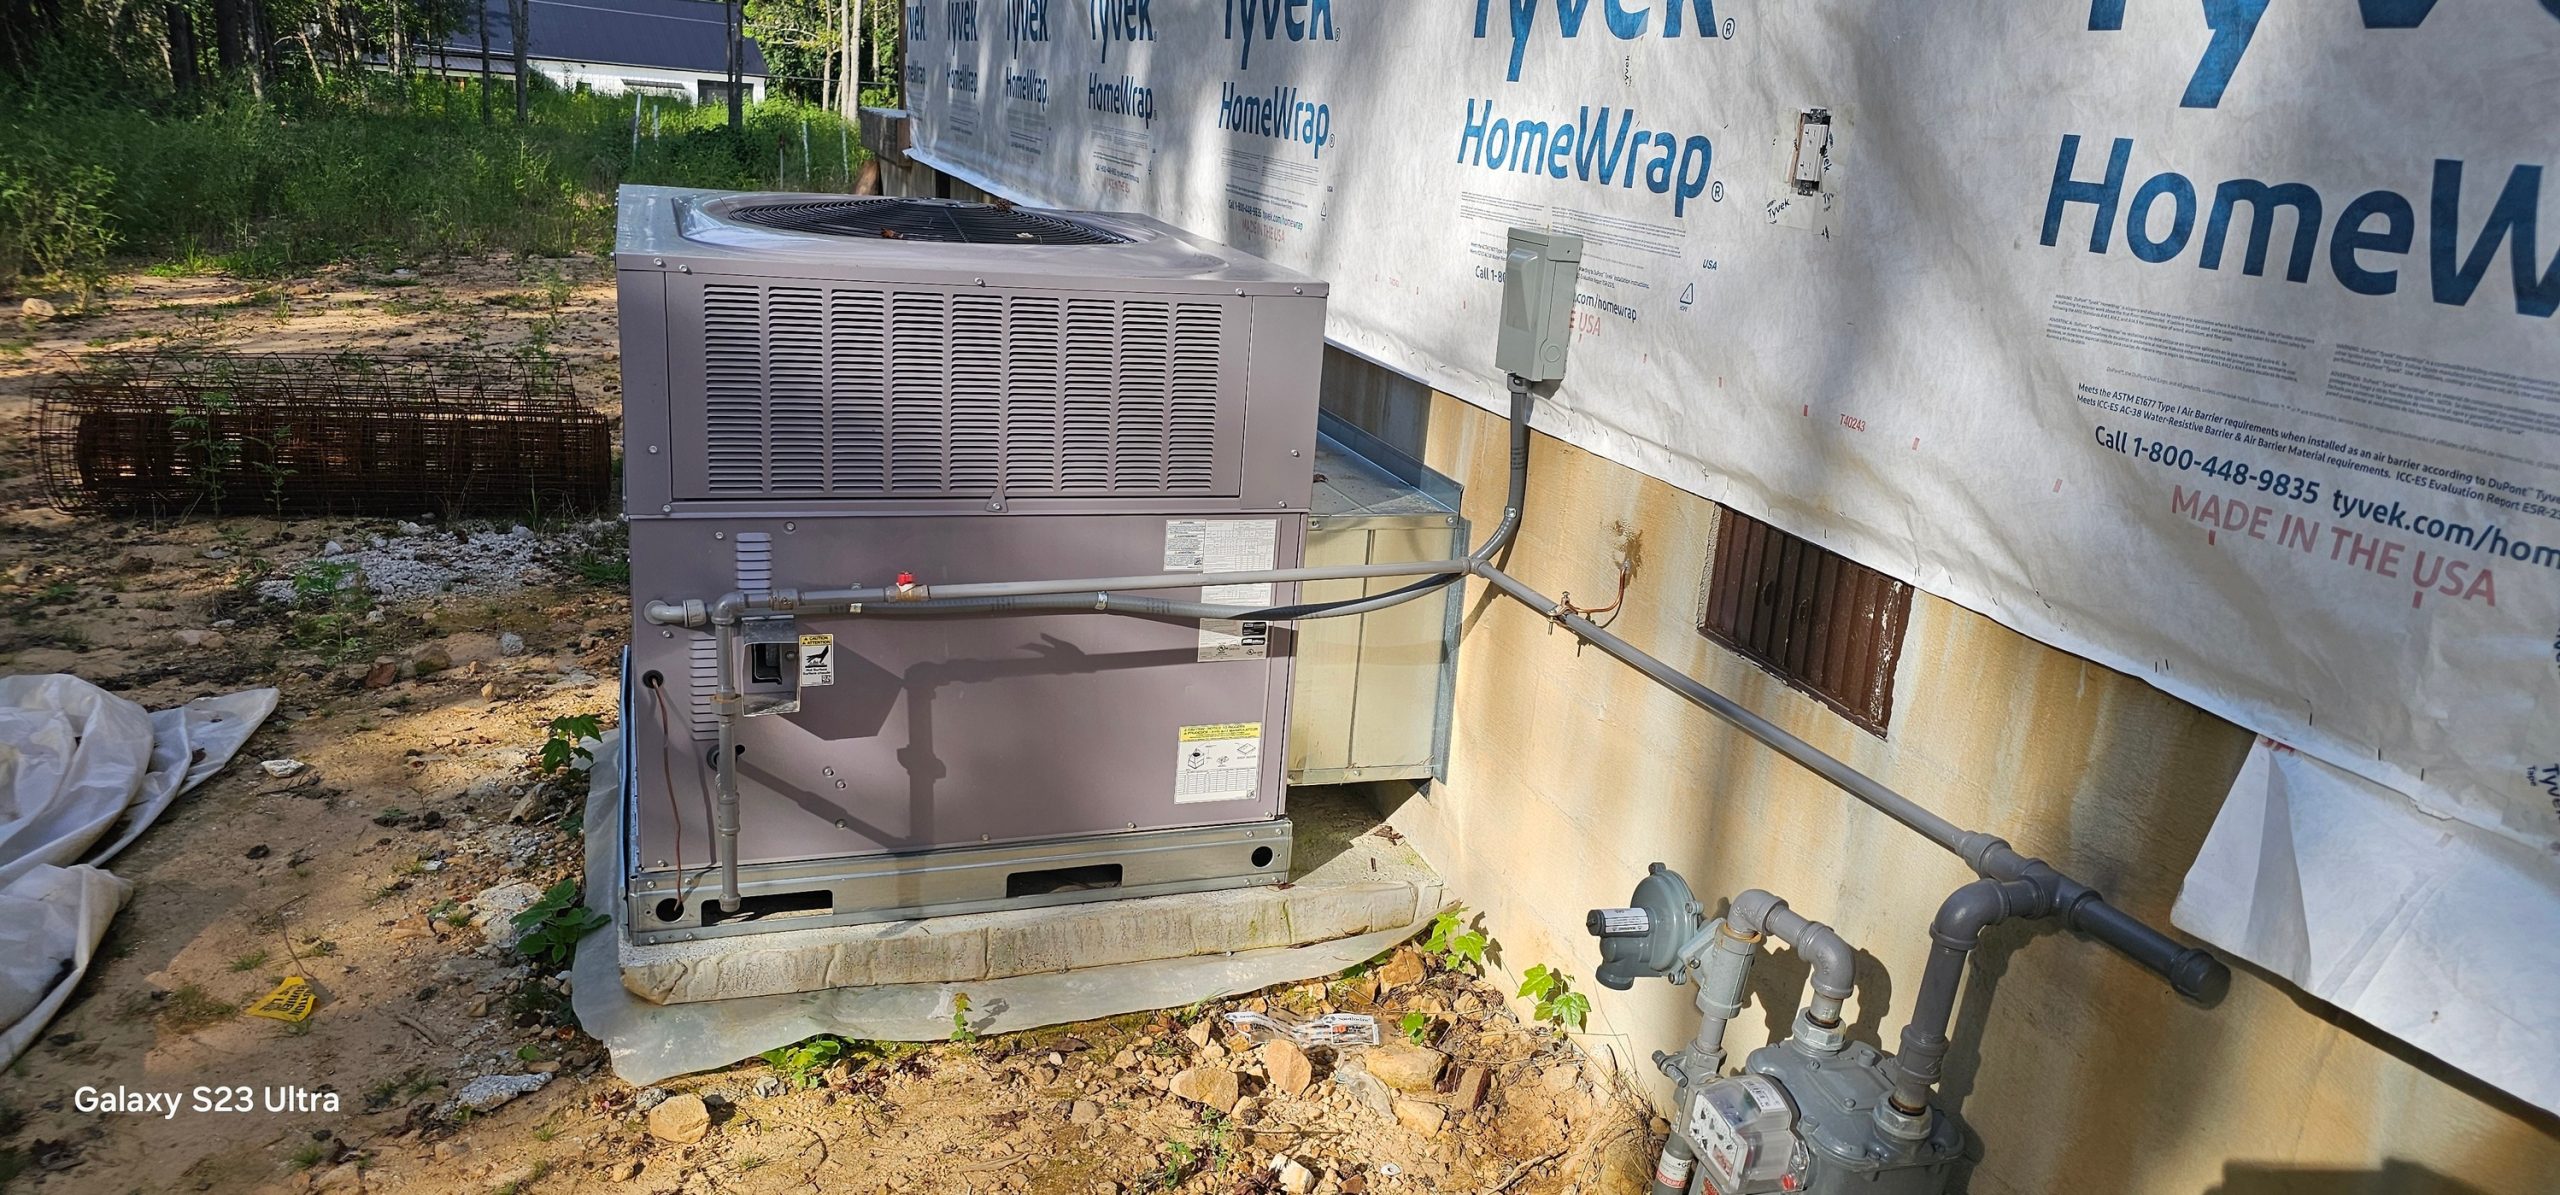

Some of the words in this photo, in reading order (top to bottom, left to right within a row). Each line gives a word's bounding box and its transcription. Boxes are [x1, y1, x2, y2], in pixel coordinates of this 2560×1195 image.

[1475, 265, 1490, 280] Call
[1702, 259, 1717, 270] USA
[1579, 312, 1601, 336] USA
[1840, 413, 1866, 432] T40243
[2078, 382, 2098, 395] Meets
[2100, 388, 2112, 398] the
[2112, 391, 2135, 404] ASTM
[2135, 396, 2156, 408] E1677
[2157, 402, 2176, 415] Type
[2181, 406, 2194, 417] Air
[2194, 409, 2224, 424] Barrier
[2224, 417, 2279, 438] requirements
[2280, 430, 2306, 443] when
[2307, 435, 2347, 453] installed
[2348, 446, 2358, 456] as
[2360, 449, 2371, 460] an
[2373, 451, 2385, 463] air
[2387, 454, 2421, 471] barrier
[2422, 464, 2473, 484] according
[2475, 475, 2486, 486] to
[2076, 394, 2096, 407] Meets
[2097, 399, 2119, 413] ICC-ES
[2120, 405, 2142, 418] AC-38
[2143, 411, 2203, 432] Water-Resistive
[2205, 424, 2234, 440] Barrier
[2235, 433, 2242, 442] &
[2243, 434, 2257, 446] Air
[2258, 437, 2287, 453] Barrier
[2288, 445, 2327, 462] Material
[2327, 455, 2391, 479] requirements.
[2395, 471, 2427, 487] ICC-ES
[2428, 479, 2485, 501] Evaluation
[2486, 493, 2520, 510] Report
[2095, 425, 2128, 455] Call
[2133, 436, 2321, 504] 1-800-448-9835
[2171, 484, 2273, 540] MADE
[2277, 513, 2320, 553] IN
[2330, 525, 2406, 578] THE
[2412, 550, 2496, 607] USA
[2538, 763, 2560, 821] Tyve
